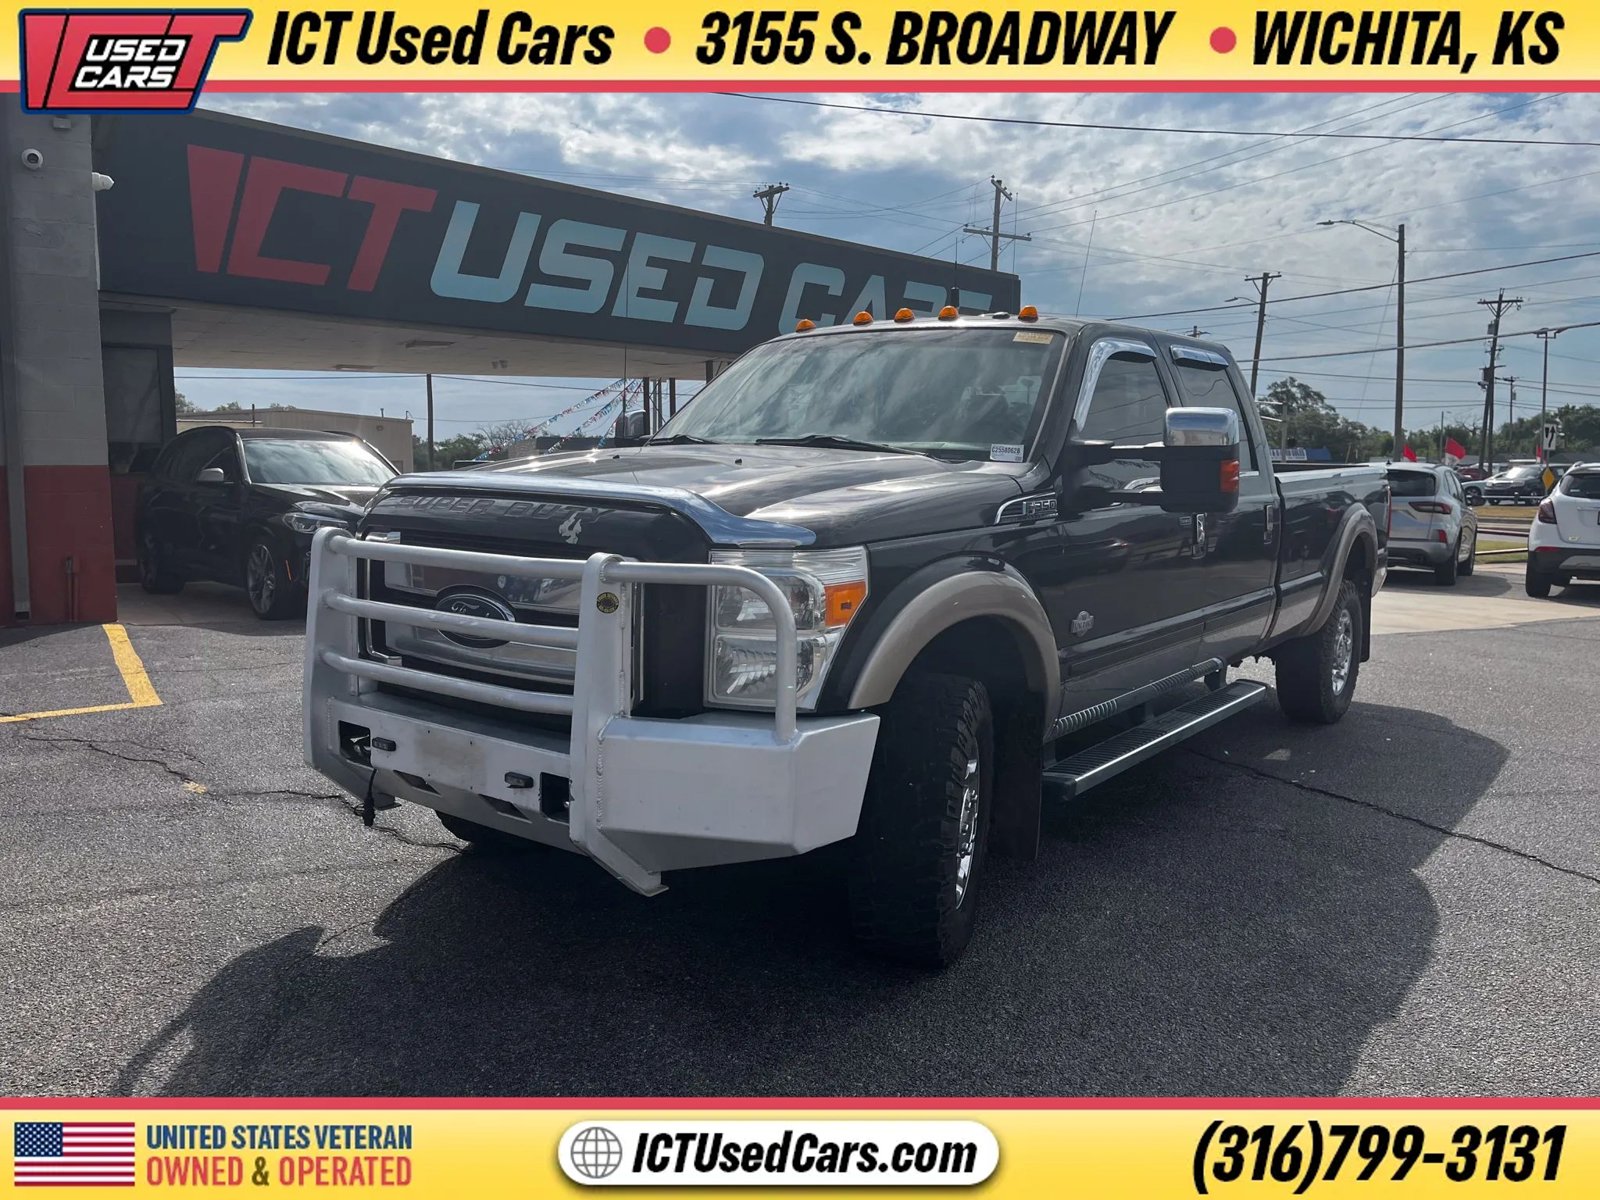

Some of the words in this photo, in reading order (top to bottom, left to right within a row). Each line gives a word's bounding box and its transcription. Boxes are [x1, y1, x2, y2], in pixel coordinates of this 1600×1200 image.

[187, 144, 439, 292] ICT
[430, 200, 765, 331] USED
[400, 496, 495, 515] SUPER
[504, 502, 616, 523] DUTY
